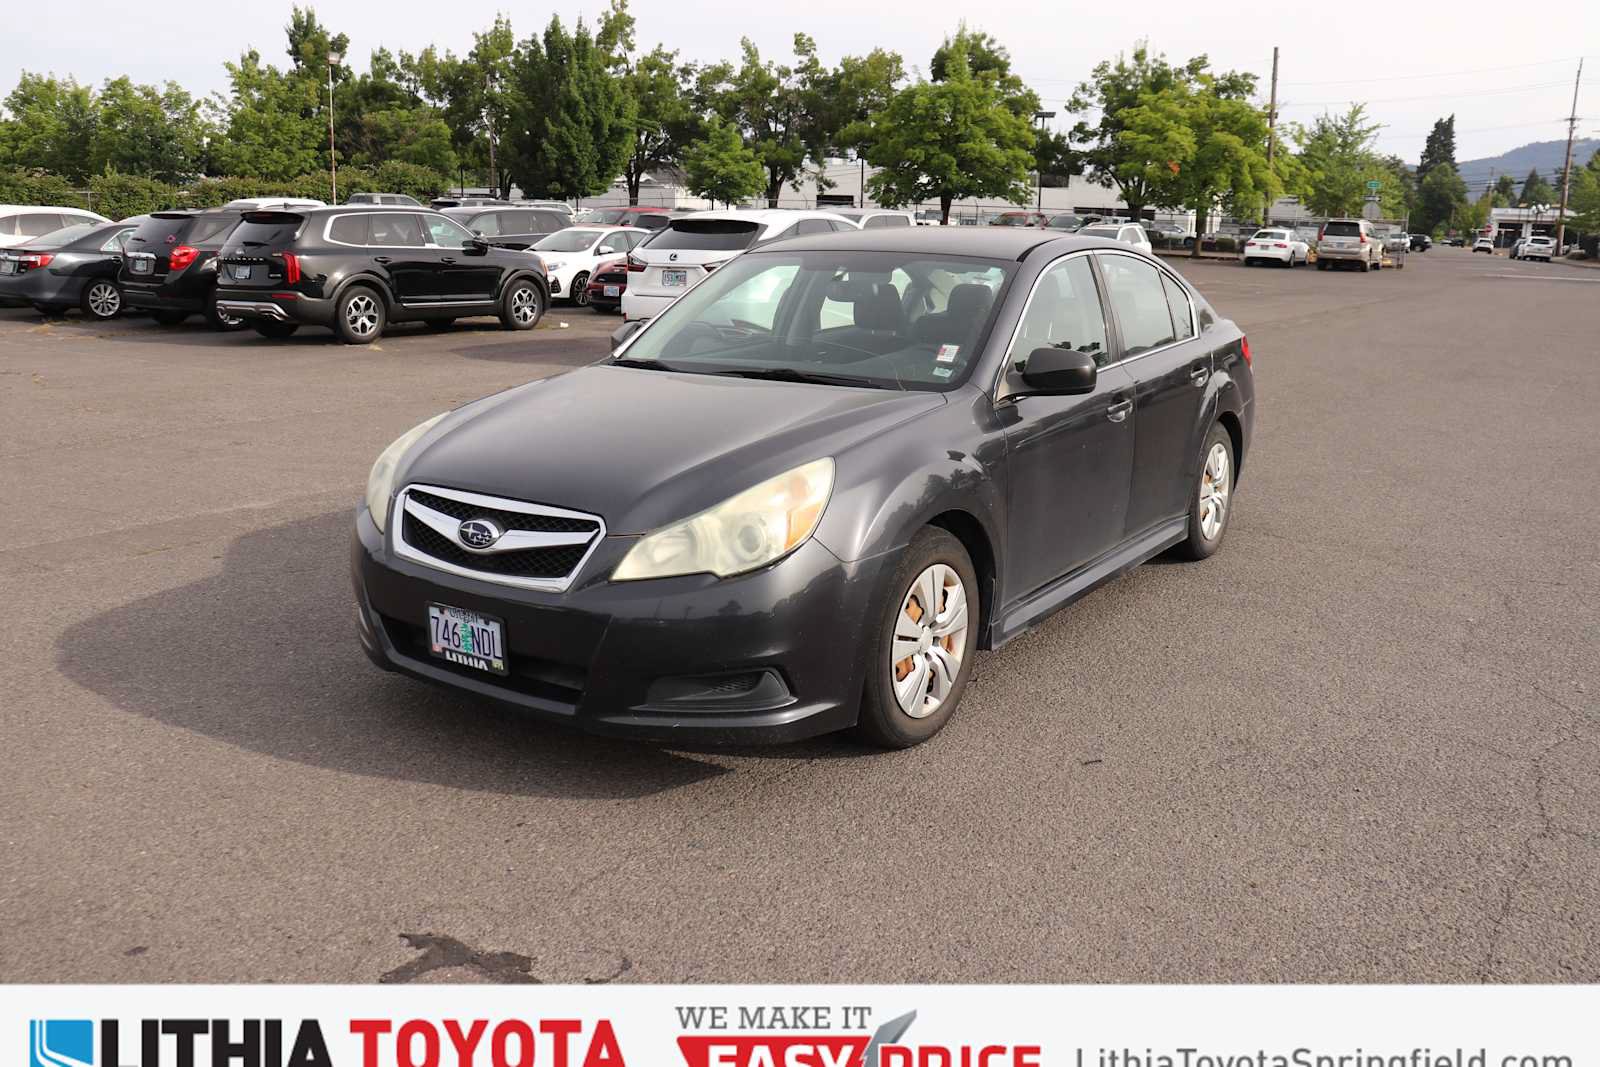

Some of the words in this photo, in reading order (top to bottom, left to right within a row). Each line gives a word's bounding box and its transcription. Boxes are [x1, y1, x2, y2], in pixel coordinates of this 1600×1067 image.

[431, 616, 461, 648] 746
[470, 625, 503, 660] NDL
[445, 650, 488, 671] LITHIA
